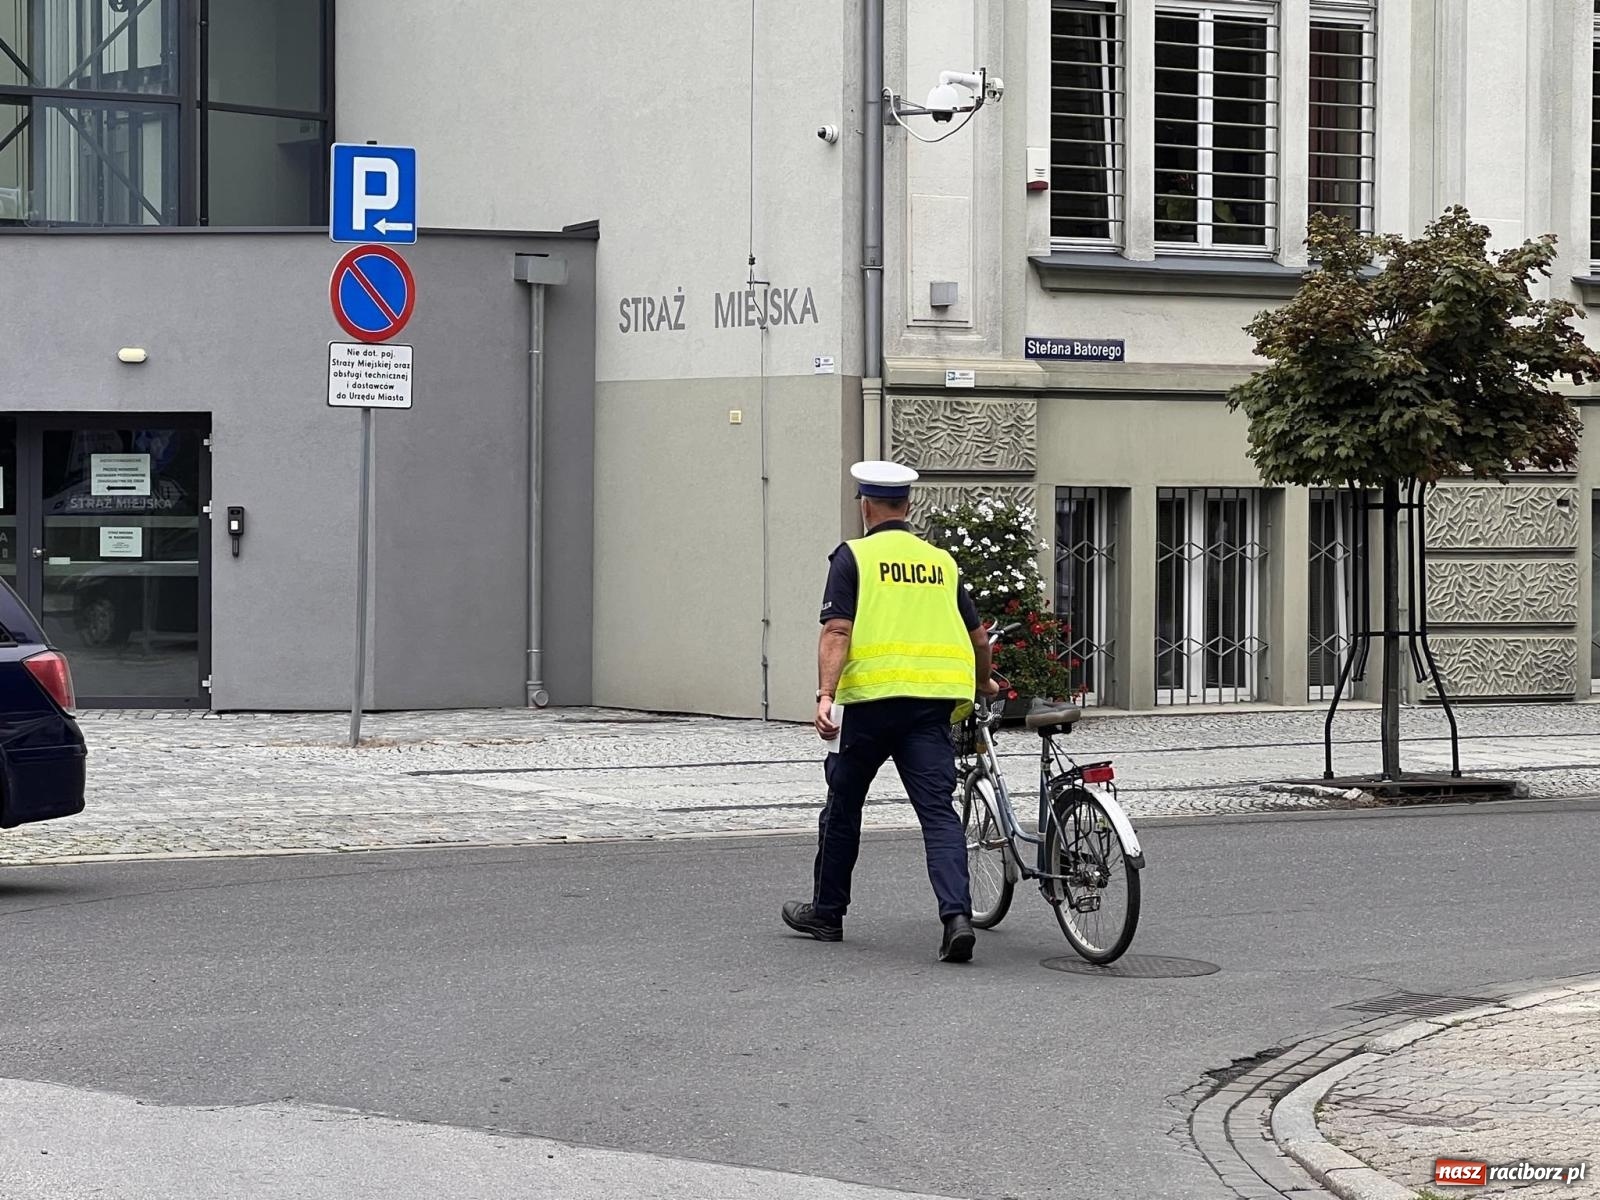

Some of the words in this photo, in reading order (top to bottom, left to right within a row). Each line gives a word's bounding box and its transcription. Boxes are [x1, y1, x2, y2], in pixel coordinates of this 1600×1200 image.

[353, 156, 399, 230] P
[619, 286, 686, 334] STRAŻ
[714, 287, 819, 329] MIEJSKA
[347, 348, 360, 357] Nie
[362, 349, 378, 357] dot.
[381, 349, 396, 359] poj.
[1027, 340, 1071, 355] Stefana
[1074, 342, 1122, 359] Batorego
[357, 359, 392, 370] Miejskiej
[333, 370, 362, 380] obsługi
[365, 372, 408, 381] technicznej
[352, 382, 394, 390] dostawców
[349, 392, 375, 402] Urzędu
[377, 393, 404, 401] Miasta
[115, 498, 173, 509] MIEJSKA
[880, 562, 944, 585] POLICJA
